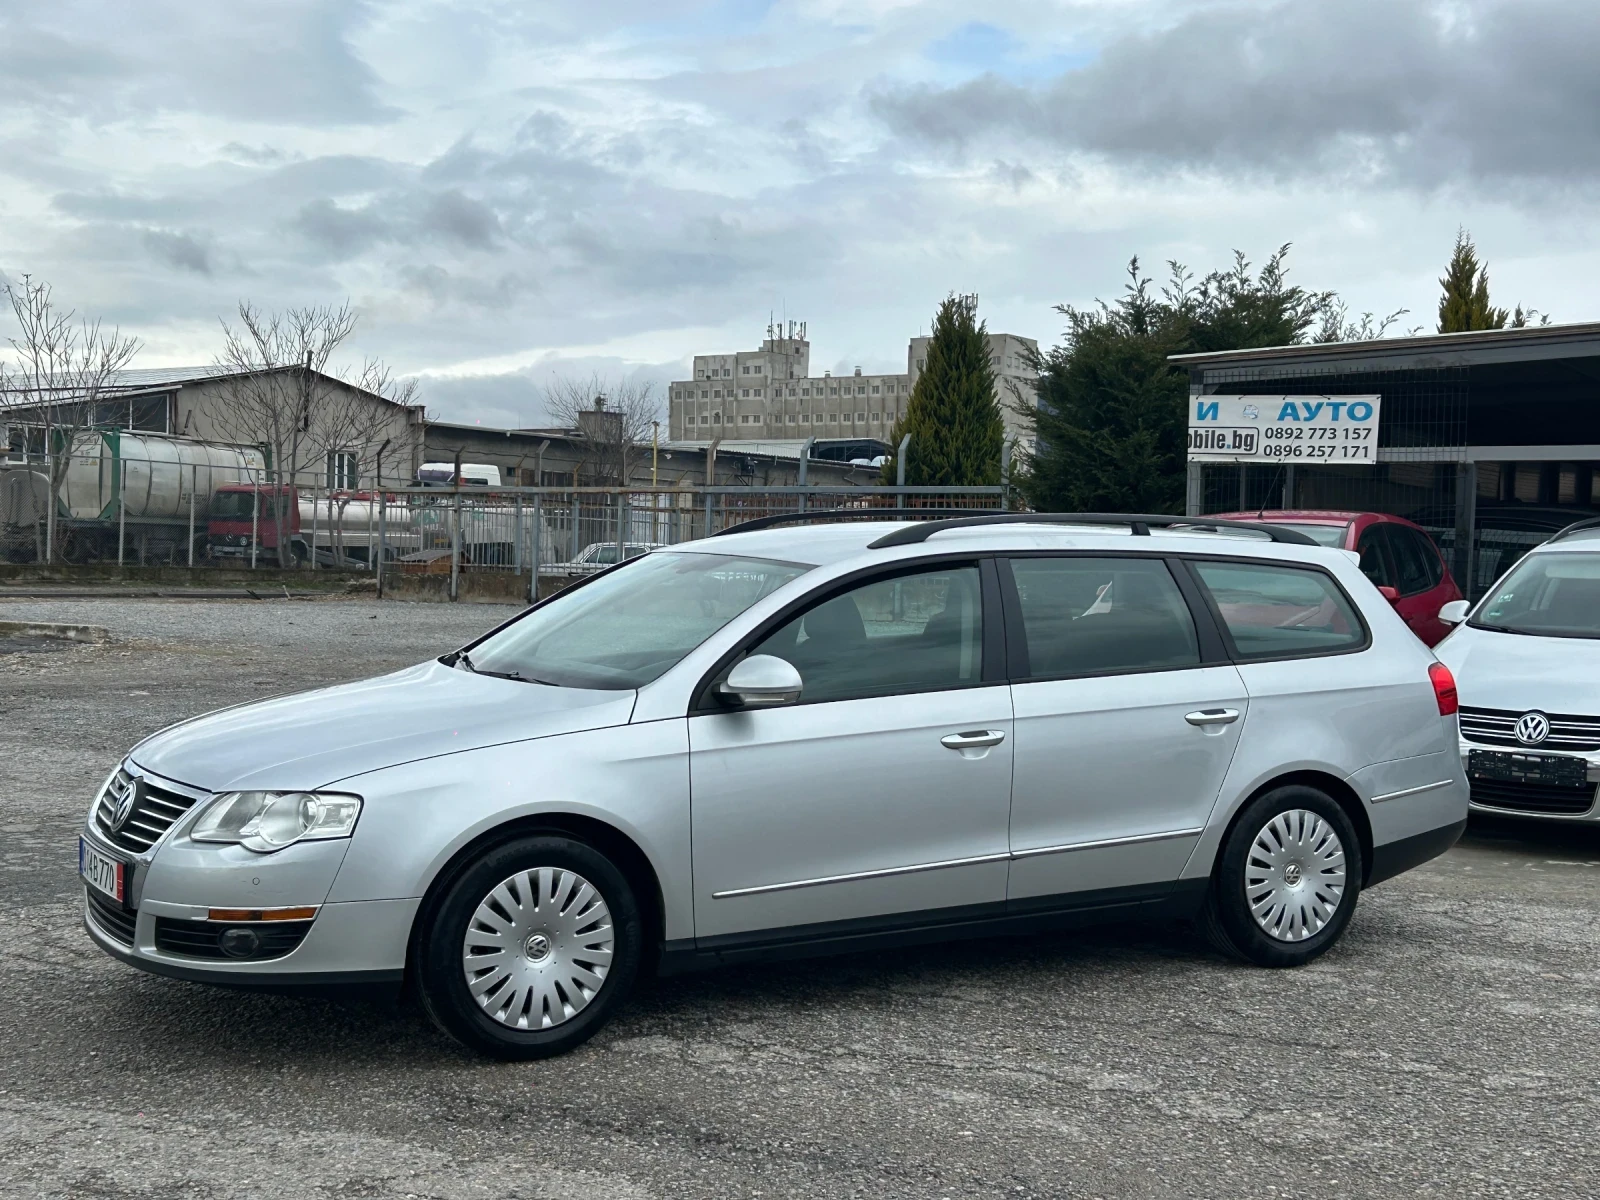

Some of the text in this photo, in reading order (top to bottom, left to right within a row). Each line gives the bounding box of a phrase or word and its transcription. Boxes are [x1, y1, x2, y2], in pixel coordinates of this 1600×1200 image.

[1196, 401, 1373, 422] И АУТО
[1264, 427, 1372, 440] 0892 773 157
[1263, 445, 1369, 458] 0896 257 171
[1514, 712, 1549, 744] VW
[112, 782, 136, 829] VW
